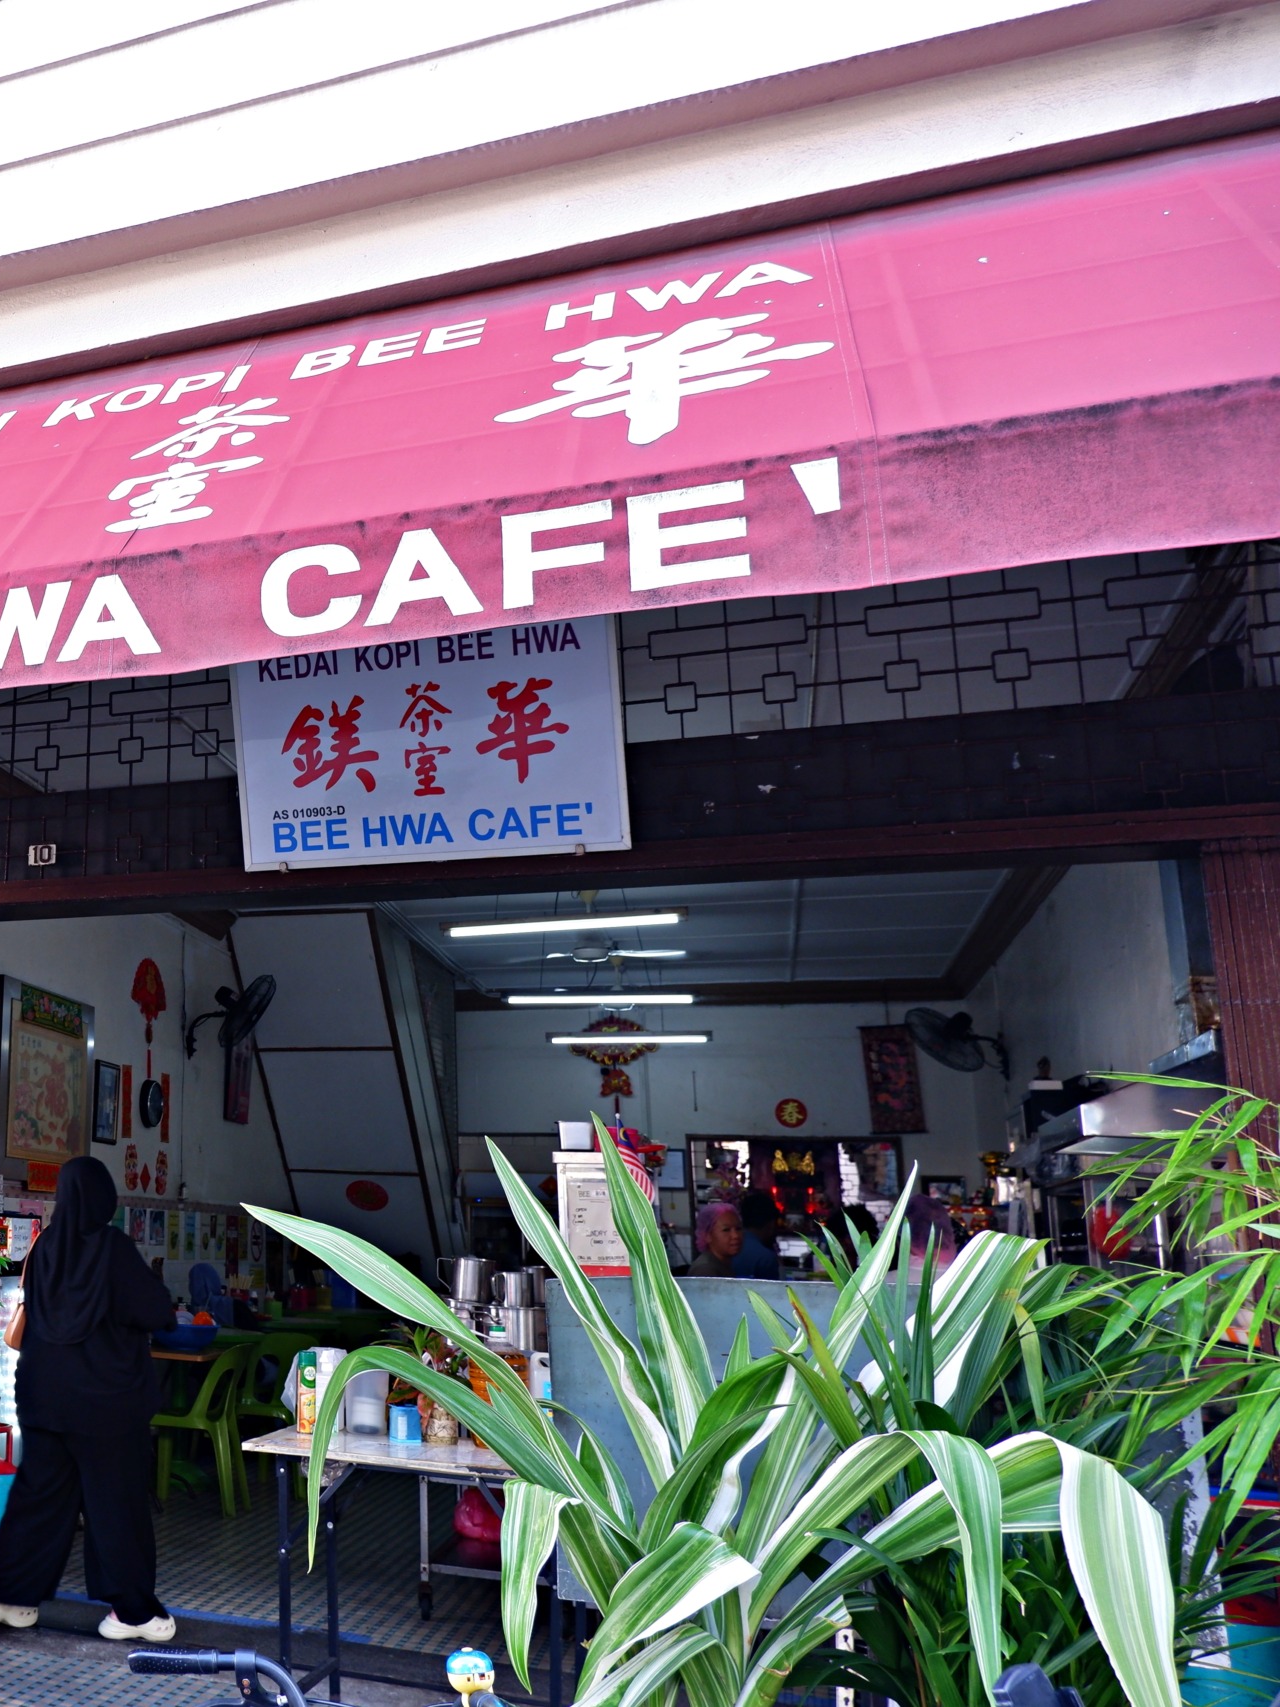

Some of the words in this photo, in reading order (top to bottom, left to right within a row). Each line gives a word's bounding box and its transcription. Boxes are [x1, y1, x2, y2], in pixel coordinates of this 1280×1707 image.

[42, 363, 252, 428] KOPI
[289, 318, 487, 381] BEE
[544, 261, 814, 332] HWA
[258, 650, 339, 682] KEDAI
[354, 639, 421, 673] KOPI
[437, 631, 495, 664] BEE
[512, 622, 581, 656] HWA
[476, 677, 570, 784] 華
[272, 810, 290, 821] AS
[292, 805, 346, 819] 010903-D
[272, 818, 350, 853] BEE
[363, 811, 454, 848] HWA
[468, 802, 594, 841] CAFE'
[32, 845, 52, 864] 10
[780, 1101, 804, 1125] 春
